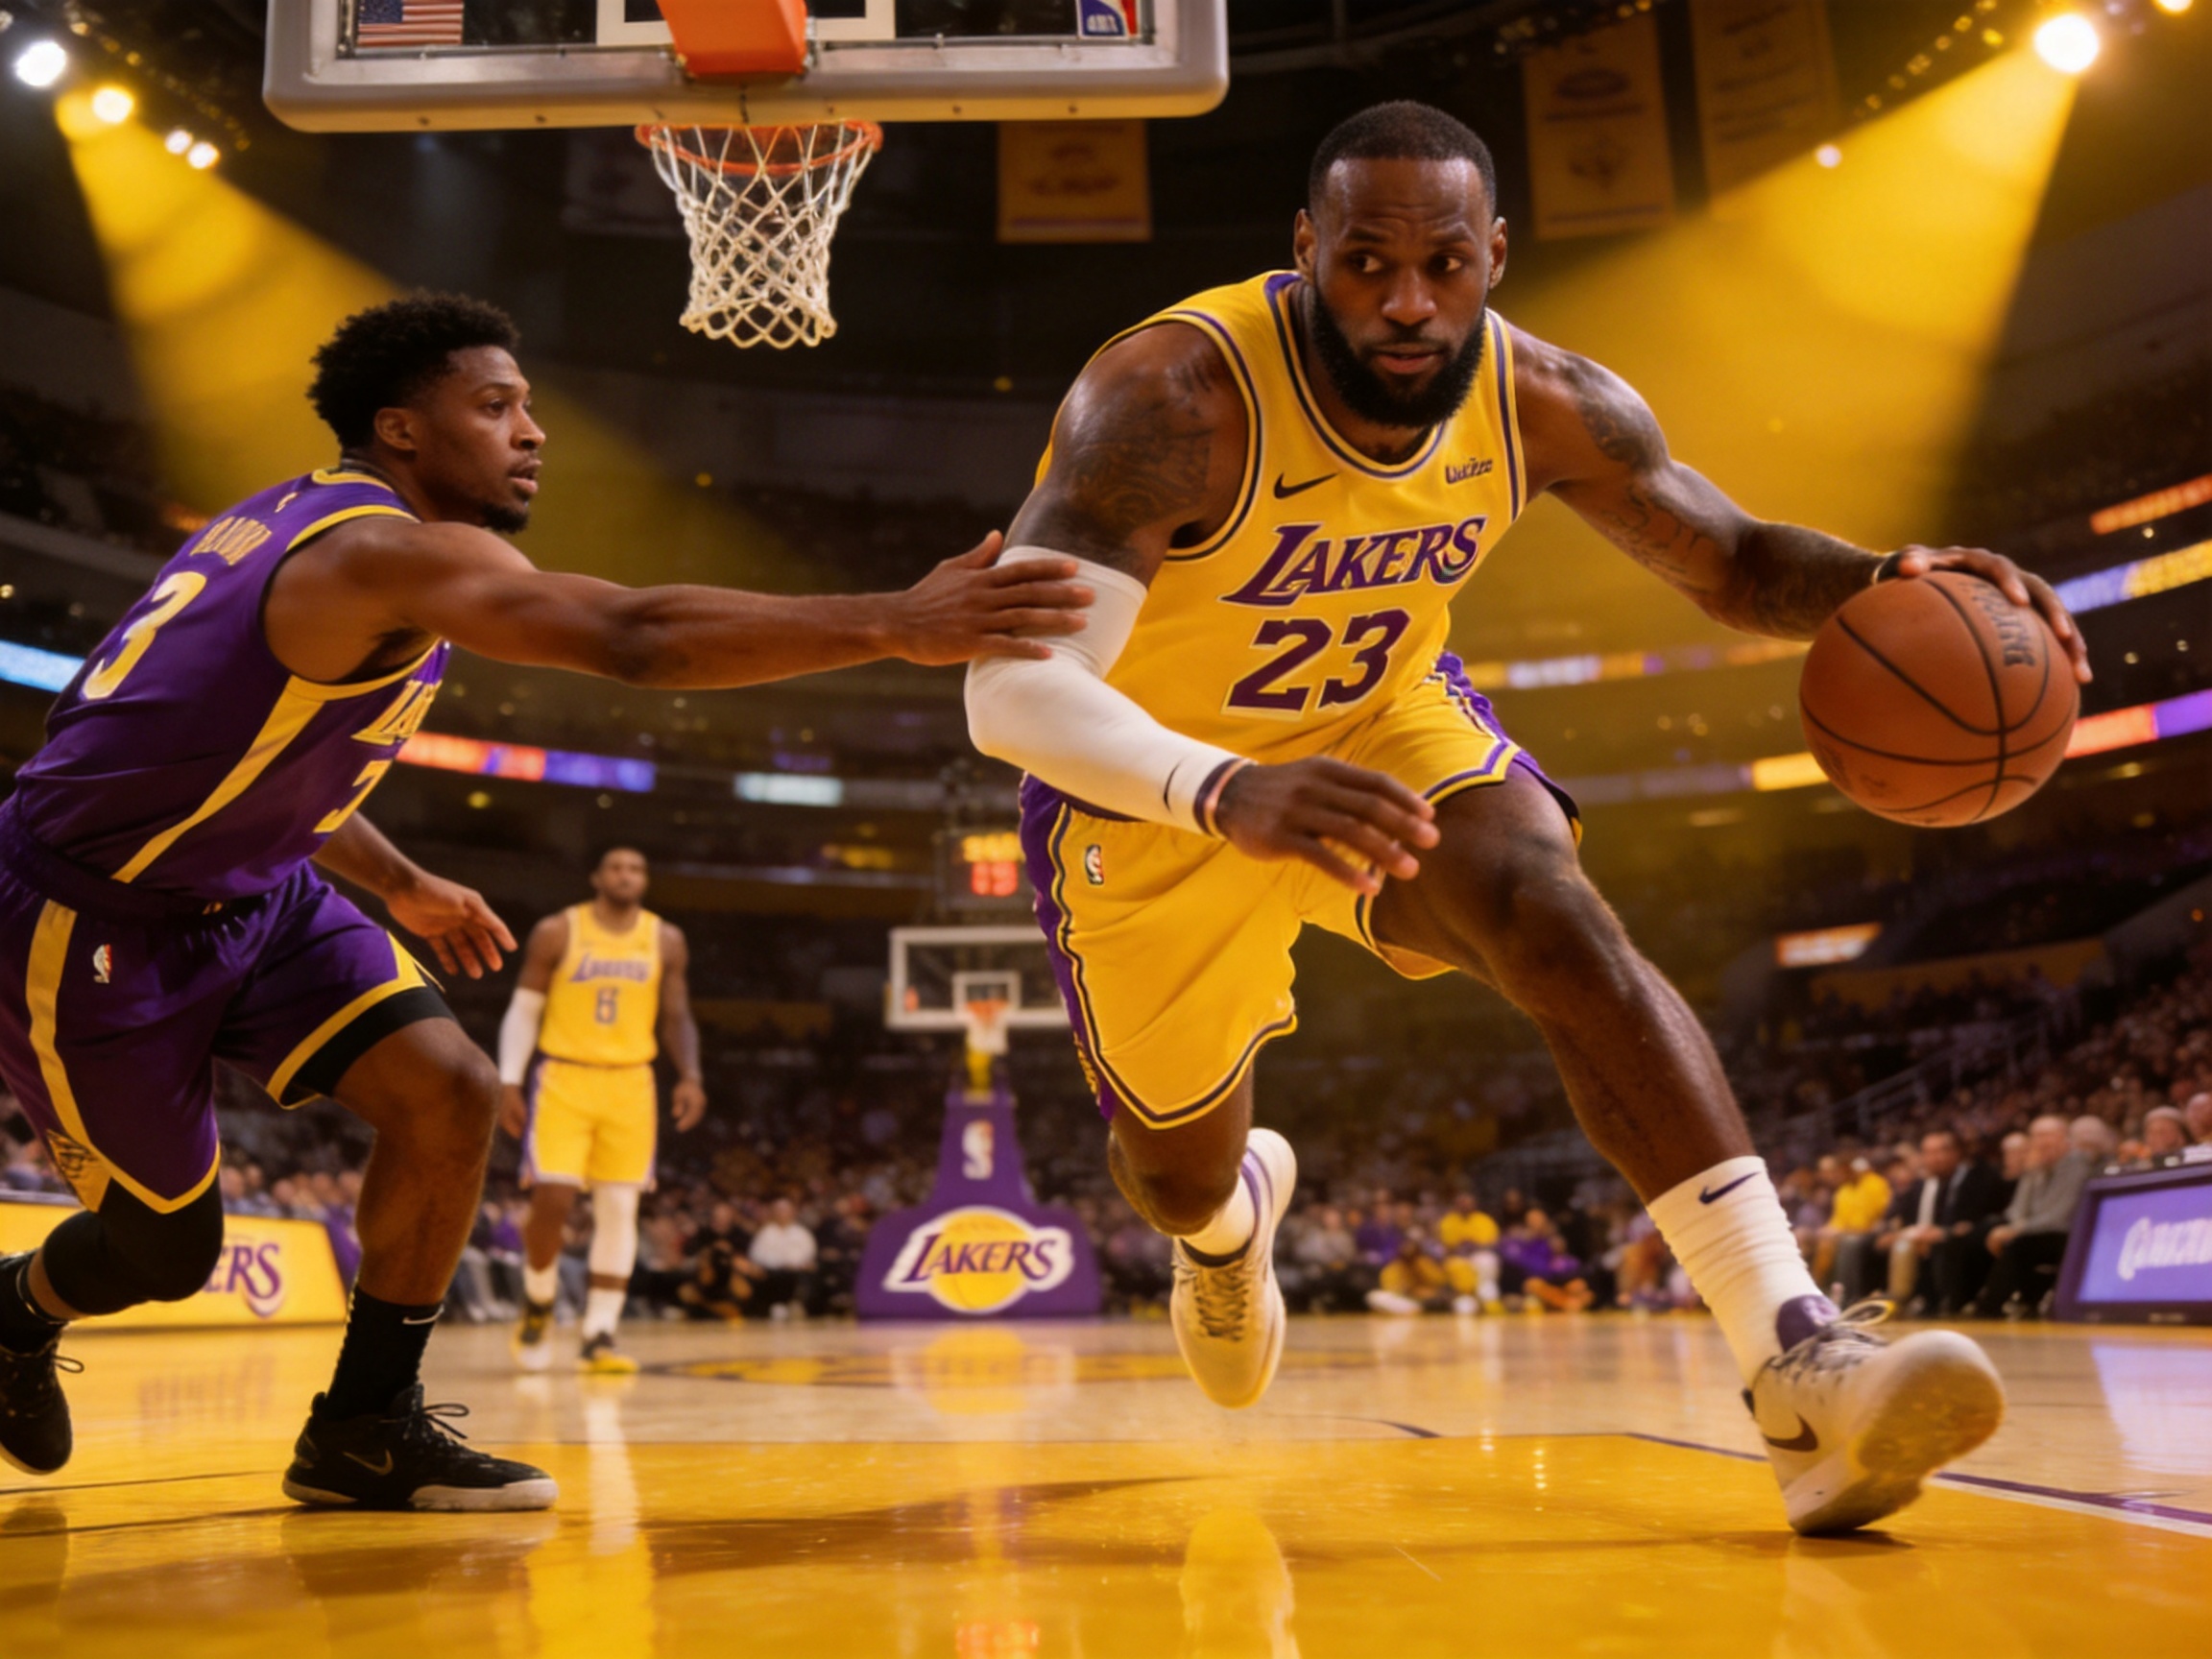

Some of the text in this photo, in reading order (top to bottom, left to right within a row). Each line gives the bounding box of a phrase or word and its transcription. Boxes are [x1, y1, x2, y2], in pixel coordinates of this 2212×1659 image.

[1217, 515, 1488, 610] LAKERS
[81, 570, 207, 701] 3
[1221, 609, 1411, 718] 23
[900, 1233, 1057, 1282] LAKERS
